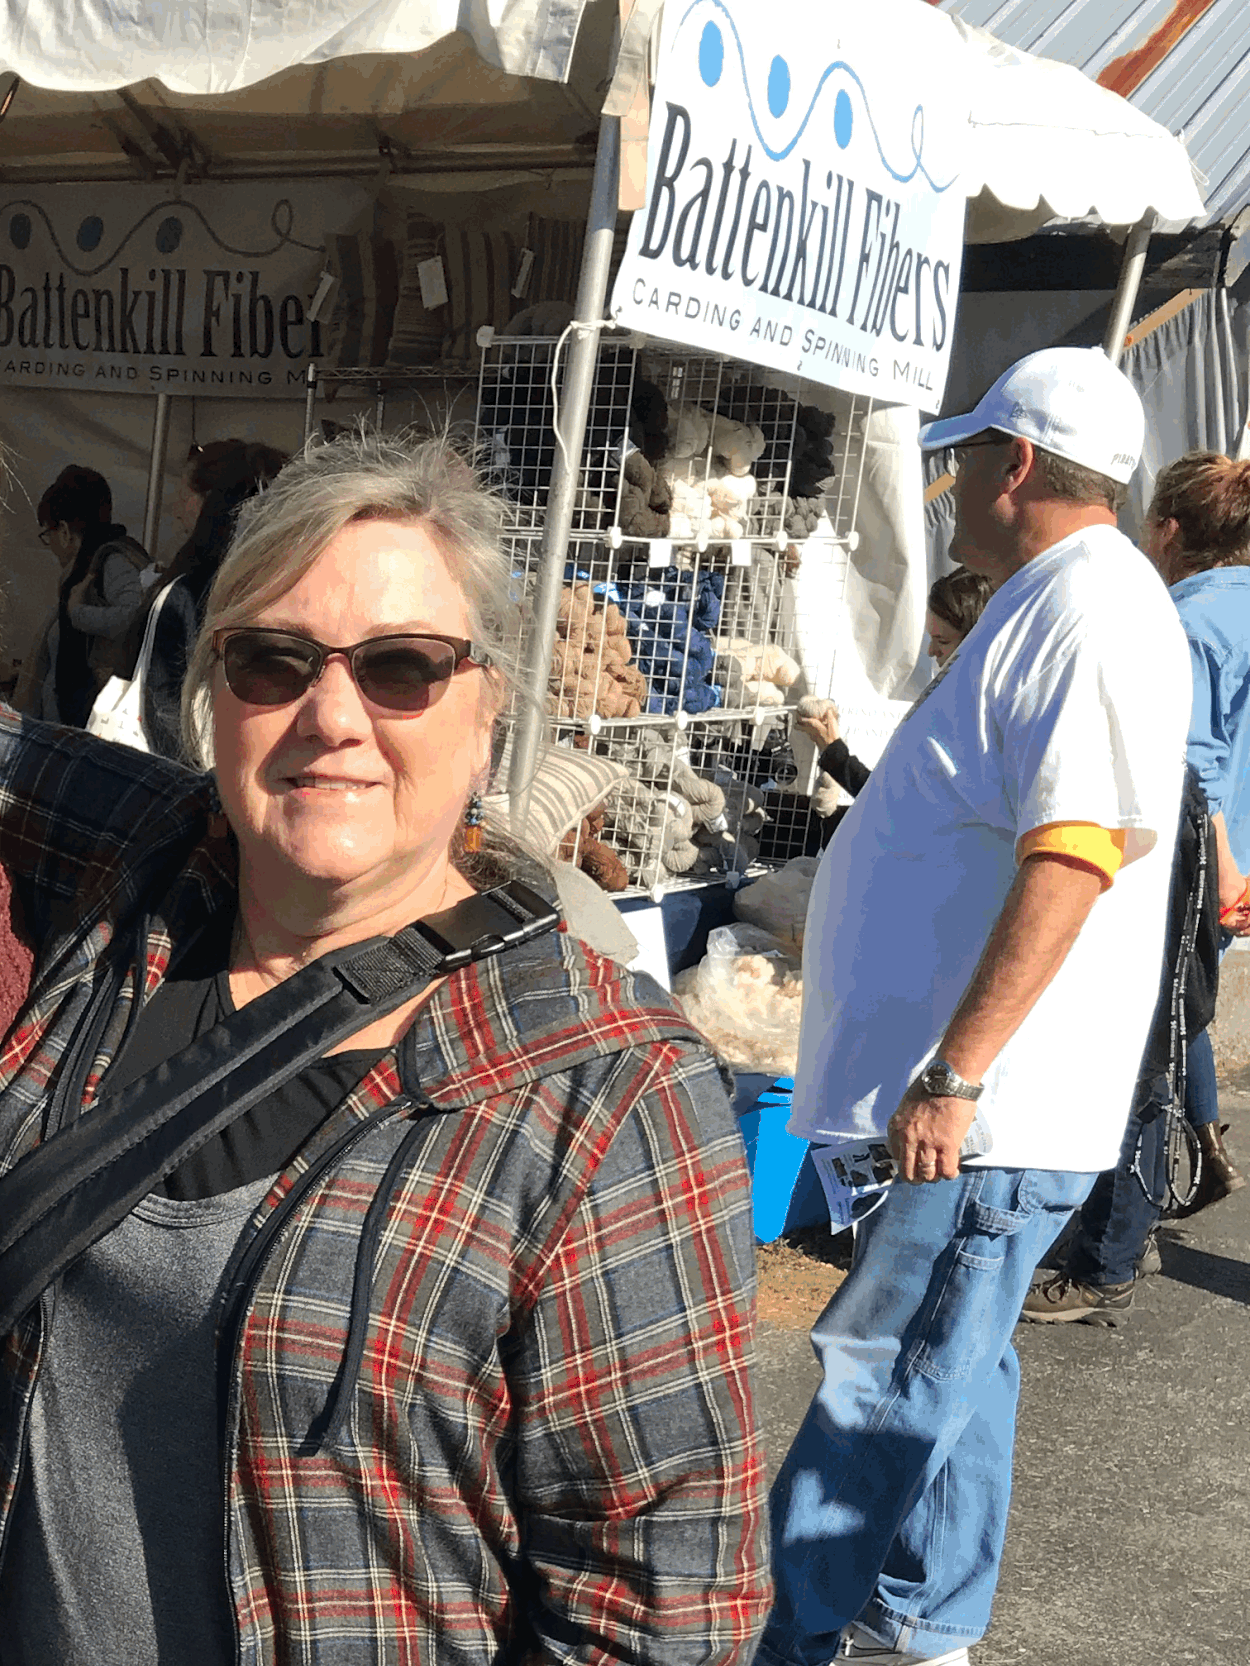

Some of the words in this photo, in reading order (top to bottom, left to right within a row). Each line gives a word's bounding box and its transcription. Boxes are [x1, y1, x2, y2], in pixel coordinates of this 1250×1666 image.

[639, 101, 854, 318] Battenkill
[846, 187, 950, 353] Fibers
[200, 270, 326, 359] Fiber
[632, 278, 741, 331] CARDING
[750, 317, 793, 347] AND
[801, 328, 879, 378] SPINNING
[893, 360, 933, 391] MILL
[95, 366, 139, 381] AND
[150, 365, 273, 386] SPINNING
